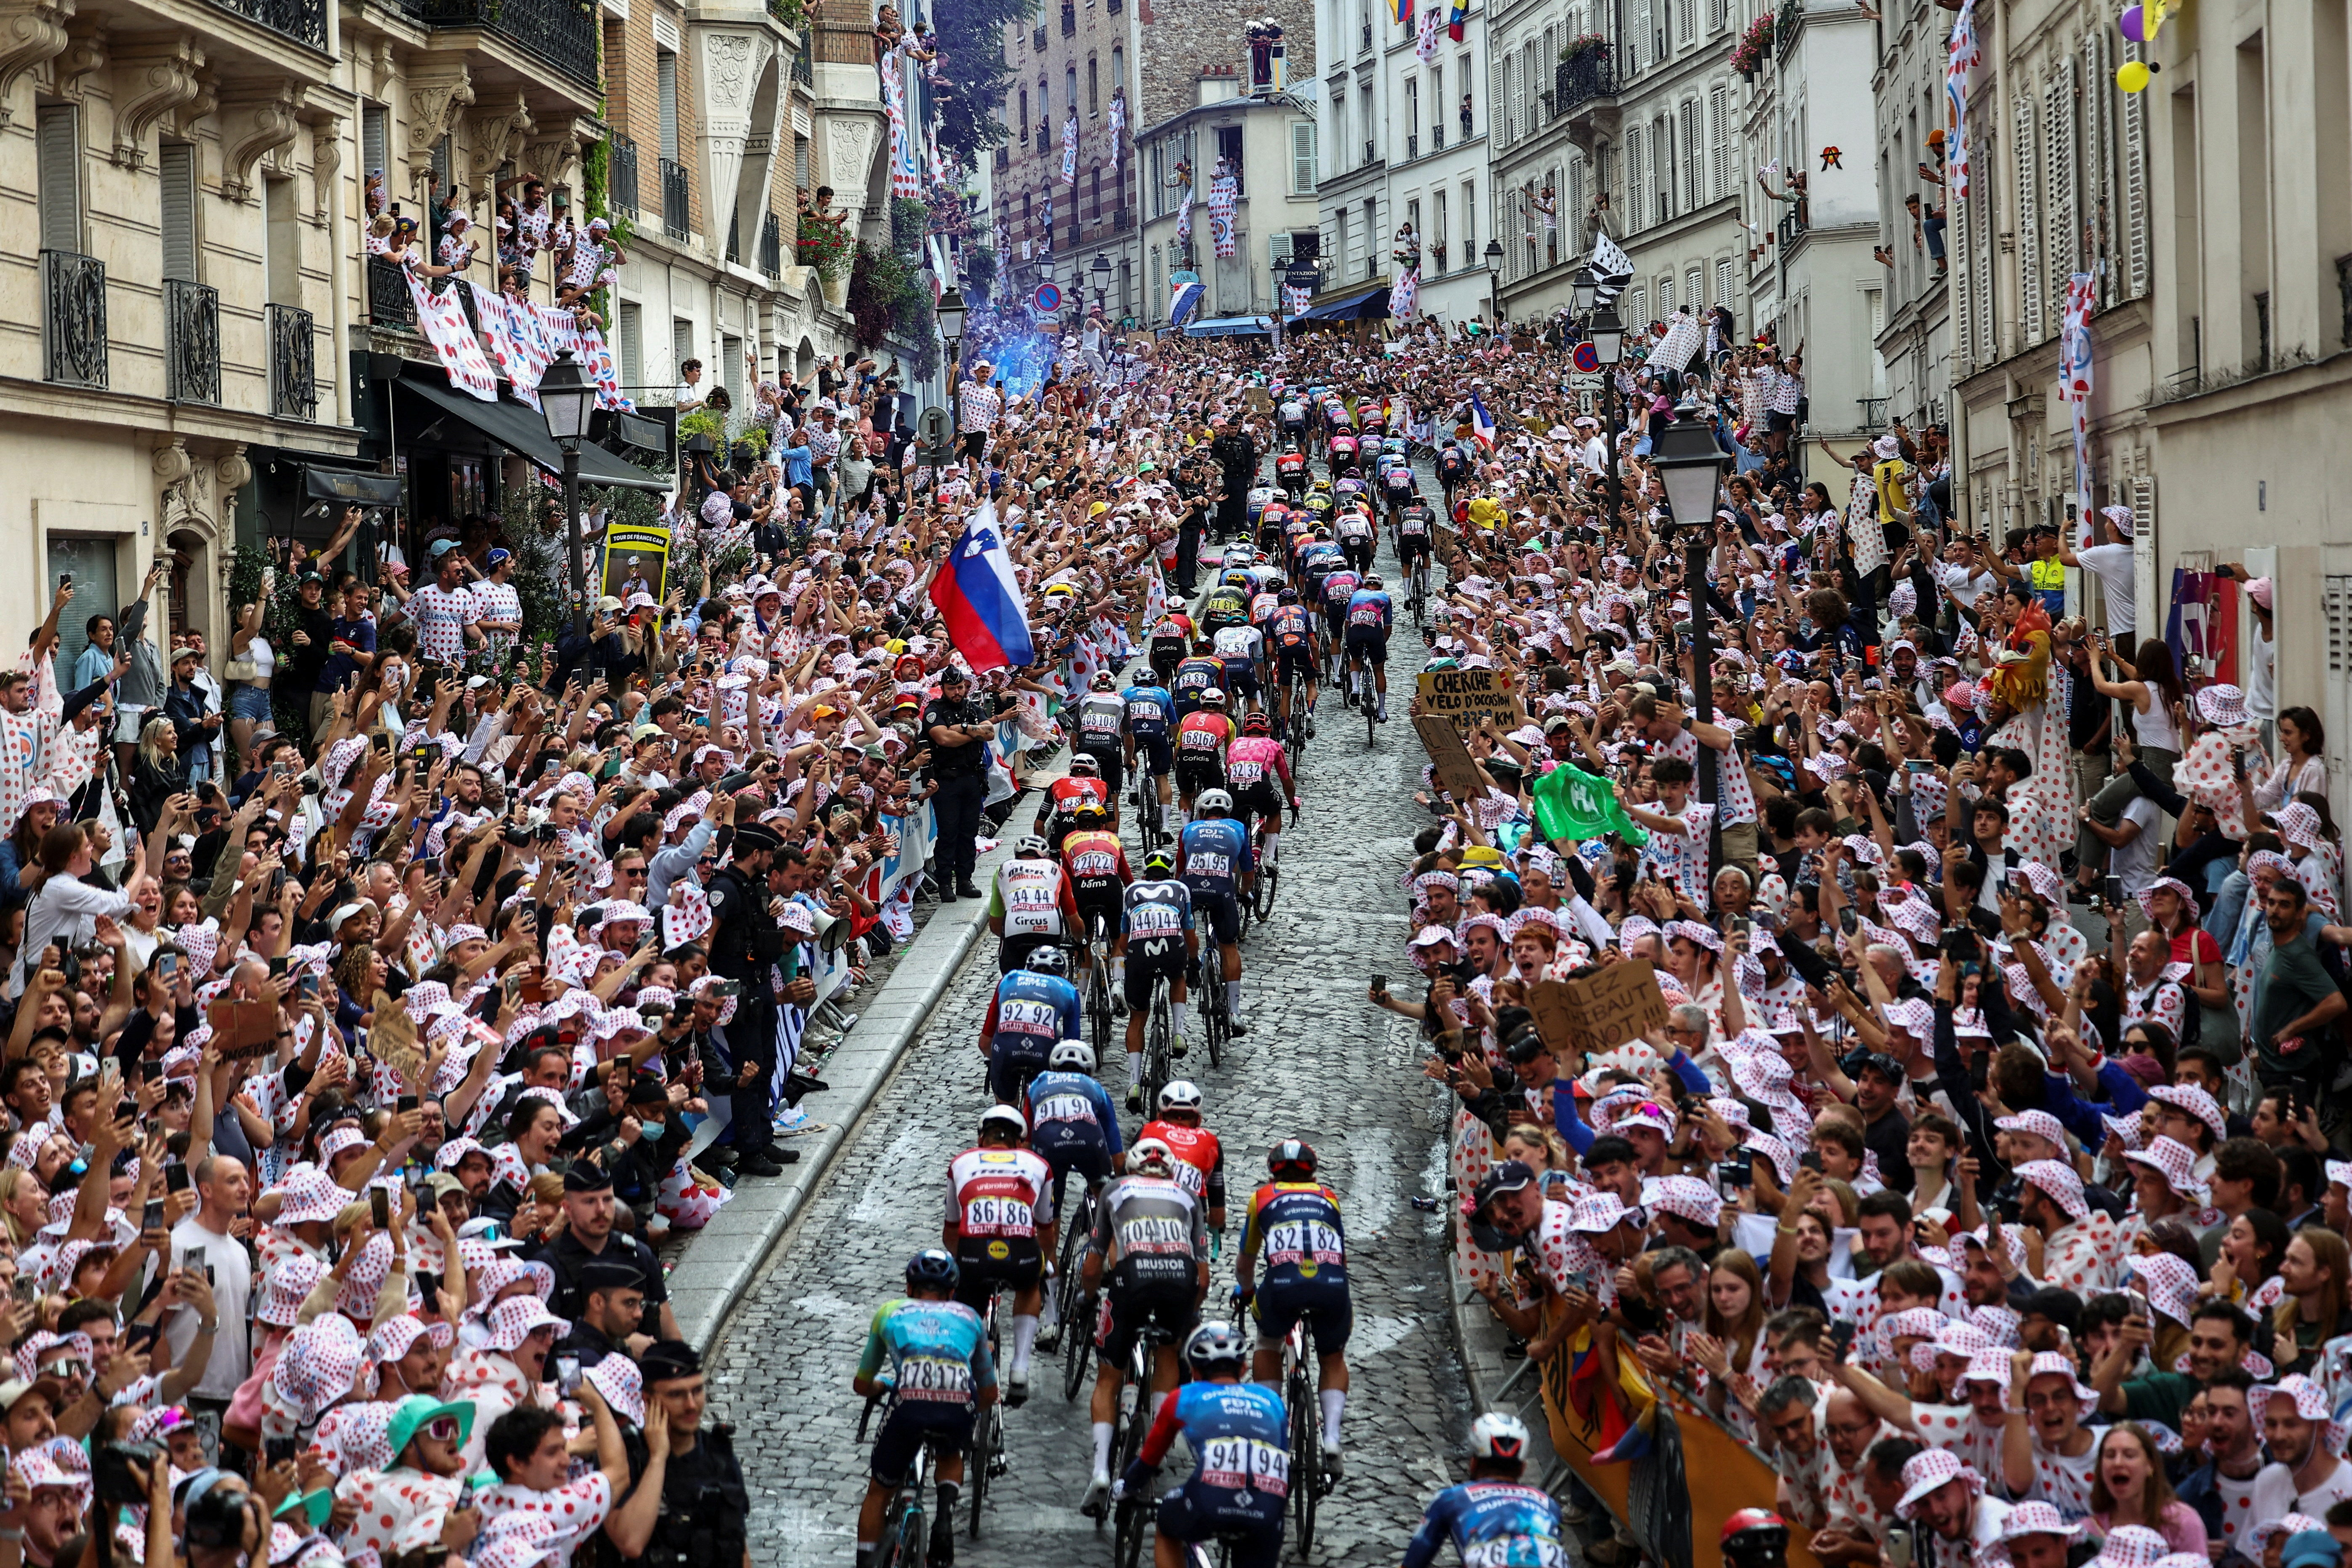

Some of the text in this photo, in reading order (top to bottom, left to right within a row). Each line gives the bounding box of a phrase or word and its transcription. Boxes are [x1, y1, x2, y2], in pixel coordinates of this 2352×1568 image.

[576, 242, 595, 255] eclerc
[1403, 522, 1423, 531] 113 113
[652, 537, 664, 545] CAM
[1441, 537, 1447, 547] GO
[1329, 585, 1354, 595] 204 204
[426, 612, 457, 622] E.Leclerc
[1165, 622, 1179, 632] 166
[1218, 643, 1245, 653] 52 52
[1194, 674, 1205, 683] 83
[1433, 671, 1492, 694] CHERCHE
[1426, 692, 1510, 709] VELO D'OCCASION
[1131, 704, 1158, 715] 97 97
[1083, 715, 1115, 726] 108 108
[1495, 711, 1515, 726] KM
[1183, 733, 1215, 747] 168 168
[1232, 764, 1261, 777] 32 32
[1063, 800, 1081, 808] 138
[911, 816, 923, 833] ATION
[1075, 855, 1115, 872] 221 221
[1190, 856, 1227, 871] 95 95
[1013, 890, 1050, 904] 44 44
[1015, 916, 1048, 926] Circus
[1132, 912, 1179, 930] 144 144
[1559, 970, 1621, 1007] ALLEZ
[1565, 981, 1648, 1026] THIBAUT
[1004, 1003, 1051, 1027] 92 92
[1000, 1021, 1053, 1037] VELUX VELUX
[1571, 1013, 1635, 1049] PINOT
[1040, 1098, 1091, 1118] 91 91
[1157, 1123, 1207, 1136] ARKEA
[1176, 1164, 1201, 1191] 136
[976, 1181, 1014, 1191] unbroken
[973, 1201, 1028, 1225] 86 86
[1284, 1207, 1320, 1216] unbroken
[969, 1225, 1032, 1238] VELUX VELUX
[1125, 1221, 1189, 1243] 104 104
[1274, 1227, 1338, 1251] 82 82
[1125, 1243, 1154, 1255] VELUX
[1136, 1258, 1185, 1270] BRUSTOR
[902, 1361, 969, 1390] 178 178
[901, 1389, 969, 1403] VELUX VELUX
[1224, 1408, 1263, 1419] UNITED
[1212, 1444, 1283, 1478] 94 94
[1205, 1473, 1242, 1485] VELUX
[1217, 1507, 1265, 1519] DISTRICLOS
